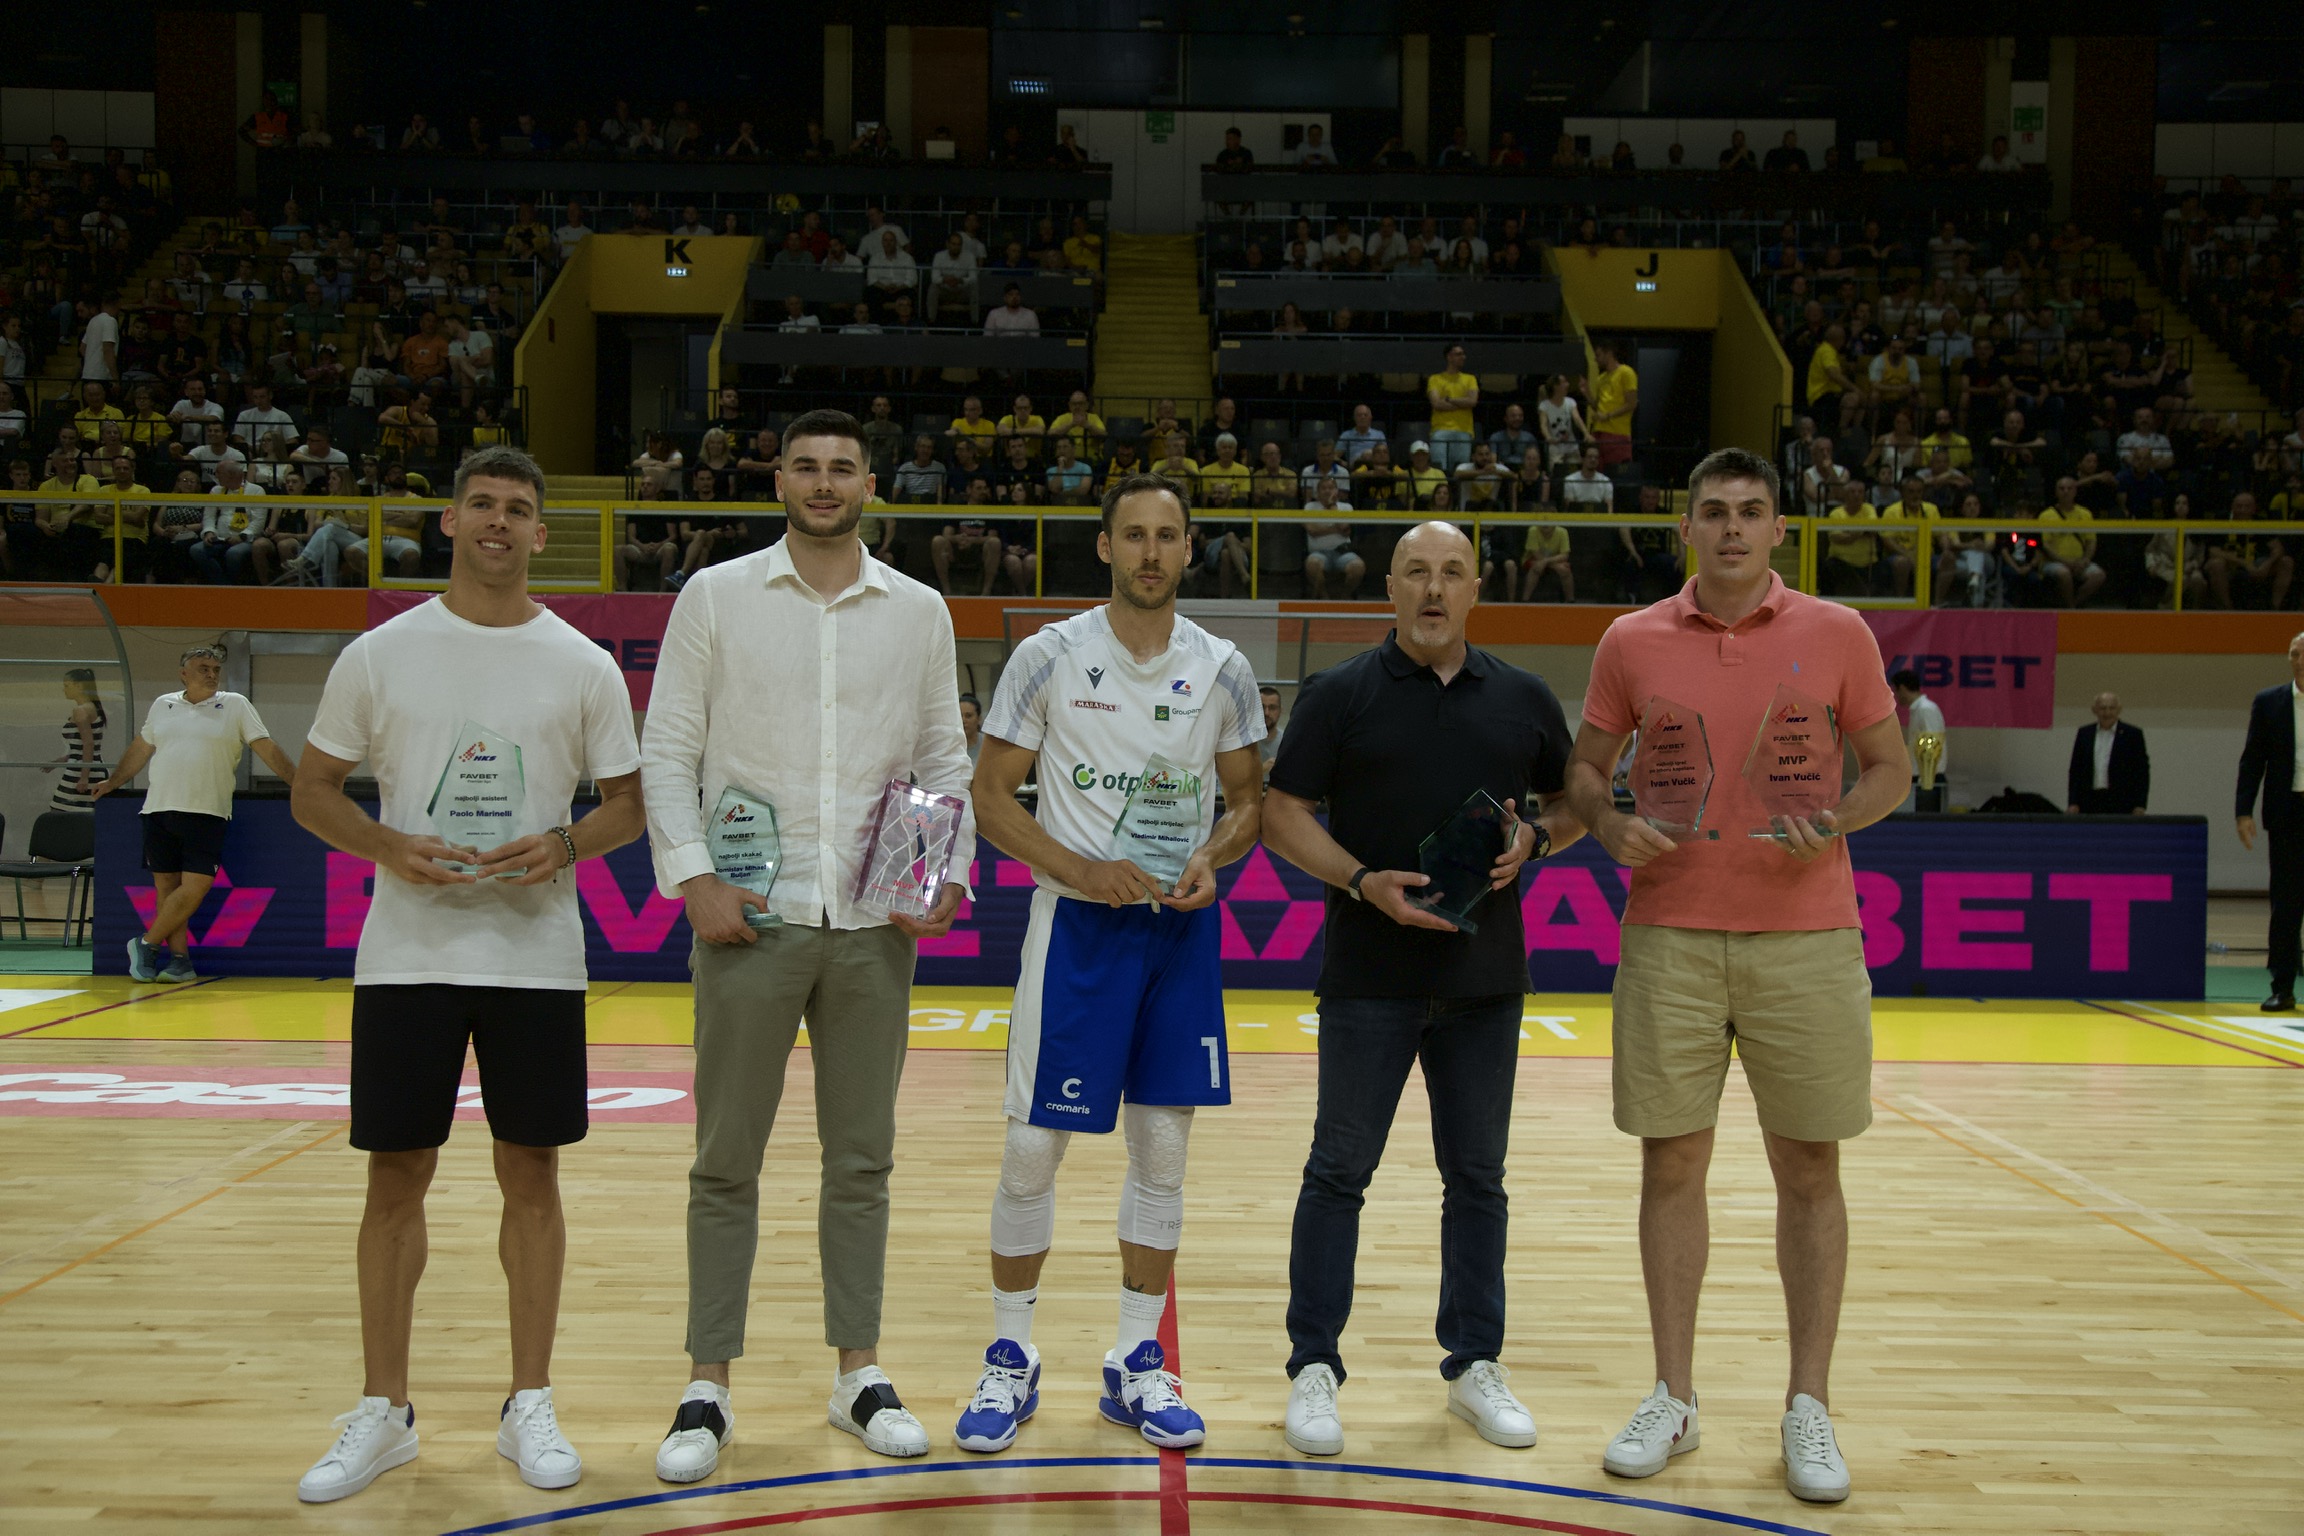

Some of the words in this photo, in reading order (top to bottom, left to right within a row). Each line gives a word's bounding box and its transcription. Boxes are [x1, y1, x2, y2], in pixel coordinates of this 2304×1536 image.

[666, 239, 693, 264] K
[1635, 253, 1659, 277] J
[1076, 700, 1115, 711] MARASKA
[1663, 724, 1683, 732] HKS
[1773, 734, 1811, 742] FAVBET
[1652, 742, 1686, 751] FAVBET
[1778, 755, 1808, 766] MVP
[1769, 774, 1791, 782] Ivan
[1793, 772, 1821, 781] Vučić
[1650, 779, 1669, 788] Ivan
[1671, 777, 1696, 786] Vučić
[1143, 798, 1178, 807] FAVBET
[734, 815, 755, 823] HKS
[1137, 818, 1160, 826] najbolji
[1160, 820, 1185, 828] strijelac
[722, 832, 756, 840] FAVBET
[1130, 832, 1157, 840] Vladimir
[1157, 834, 1190, 843] Mihailović
[718, 852, 741, 860] najbolji
[730, 871, 751, 879] Buljan
[893, 879, 915, 890] MVP
[1201, 1036, 1221, 1089] 1
[1045, 1102, 1091, 1115] cromaris
